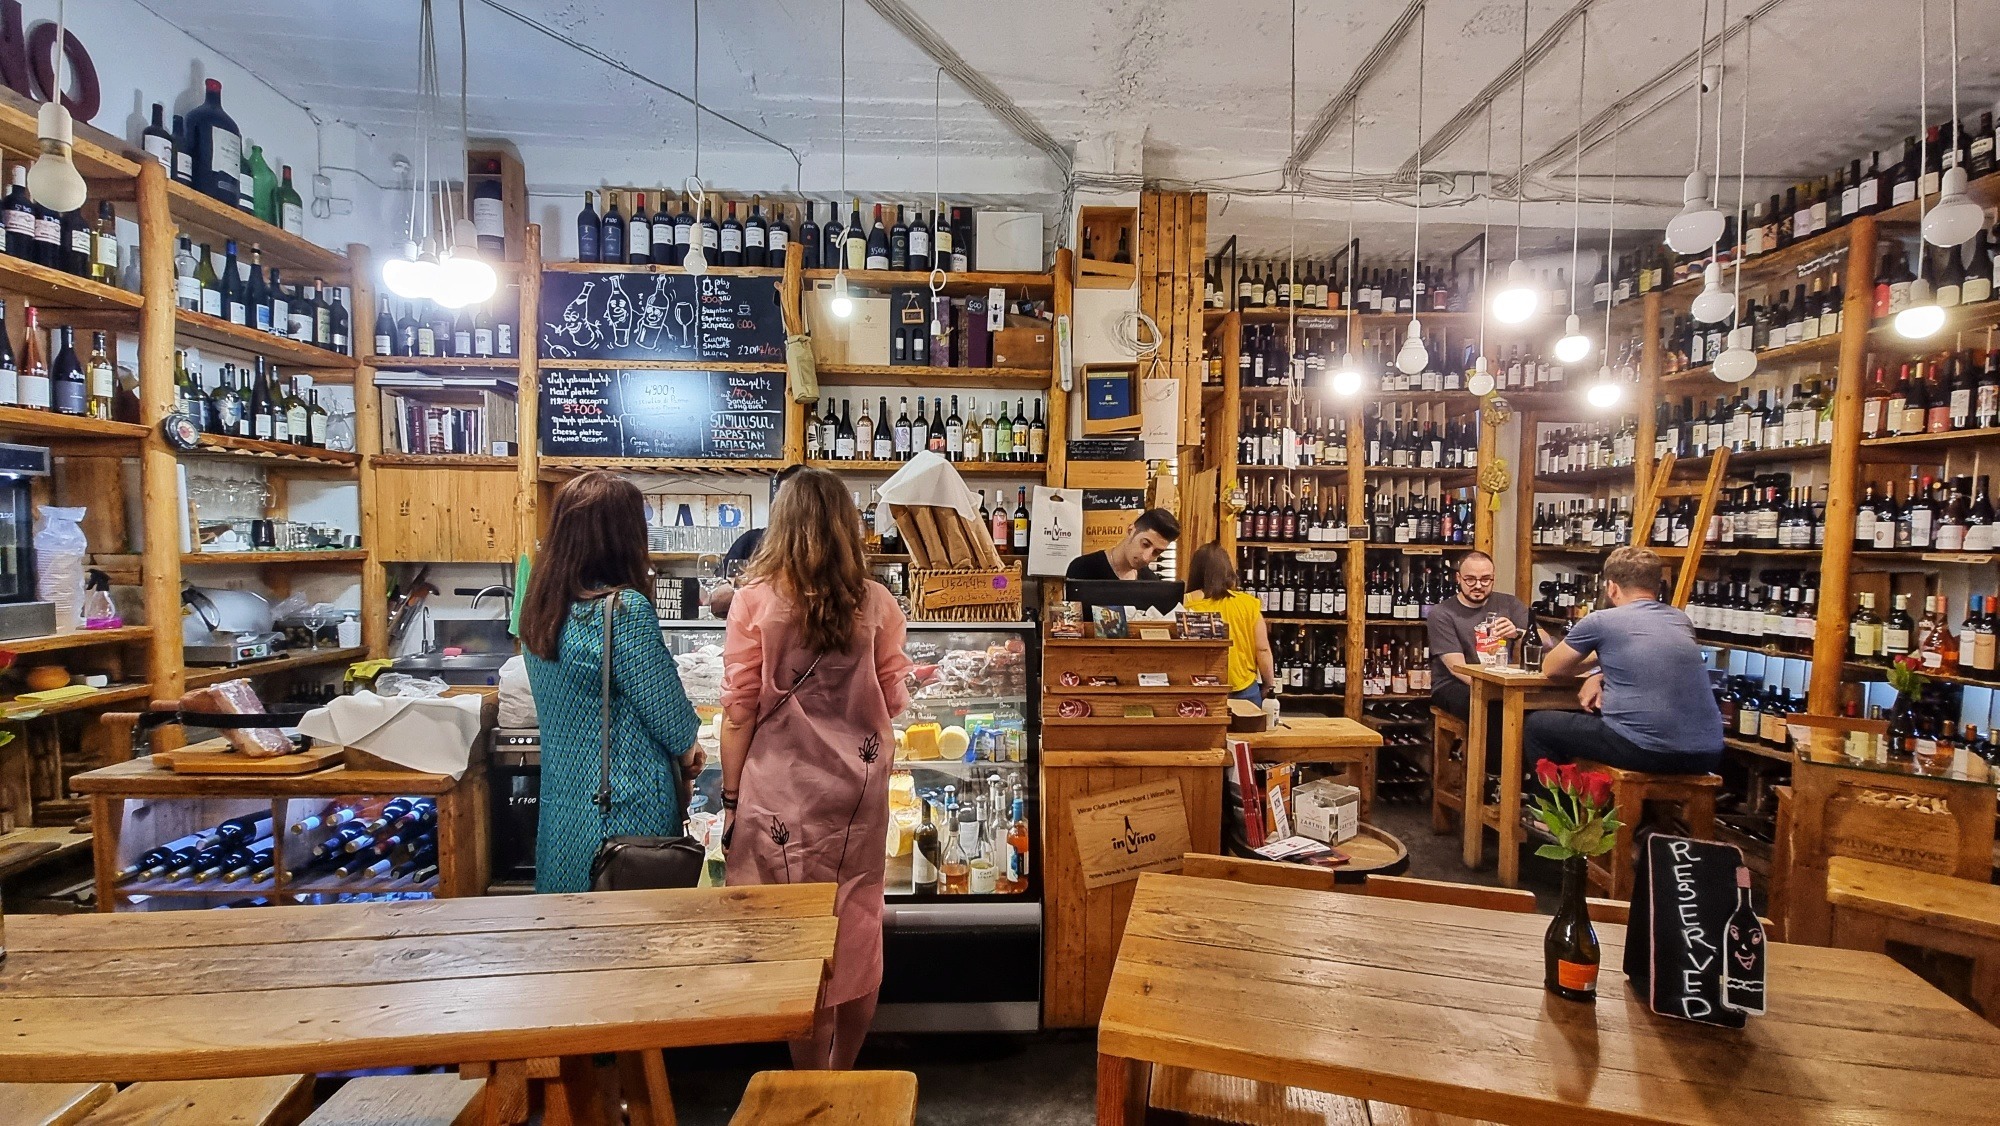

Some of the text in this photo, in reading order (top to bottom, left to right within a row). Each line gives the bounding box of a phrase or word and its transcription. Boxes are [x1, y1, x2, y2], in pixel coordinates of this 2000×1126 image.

[550, 387, 599, 398] Meat platter
[711, 430, 765, 440] TAPASTAN
[1086, 526, 1123, 536] CAPARZO
[656, 578, 682, 588] LOVE THE
[656, 588, 682, 599] WINE
[940, 593, 992, 605] Sandwich
[656, 599, 682, 610] YOU'RE
[656, 608, 682, 620] WITH
[1093, 803, 1107, 811] Club
[1108, 800, 1118, 808] and
[1119, 794, 1146, 805] Merchant
[1668, 841, 1718, 1019] RESERVED
